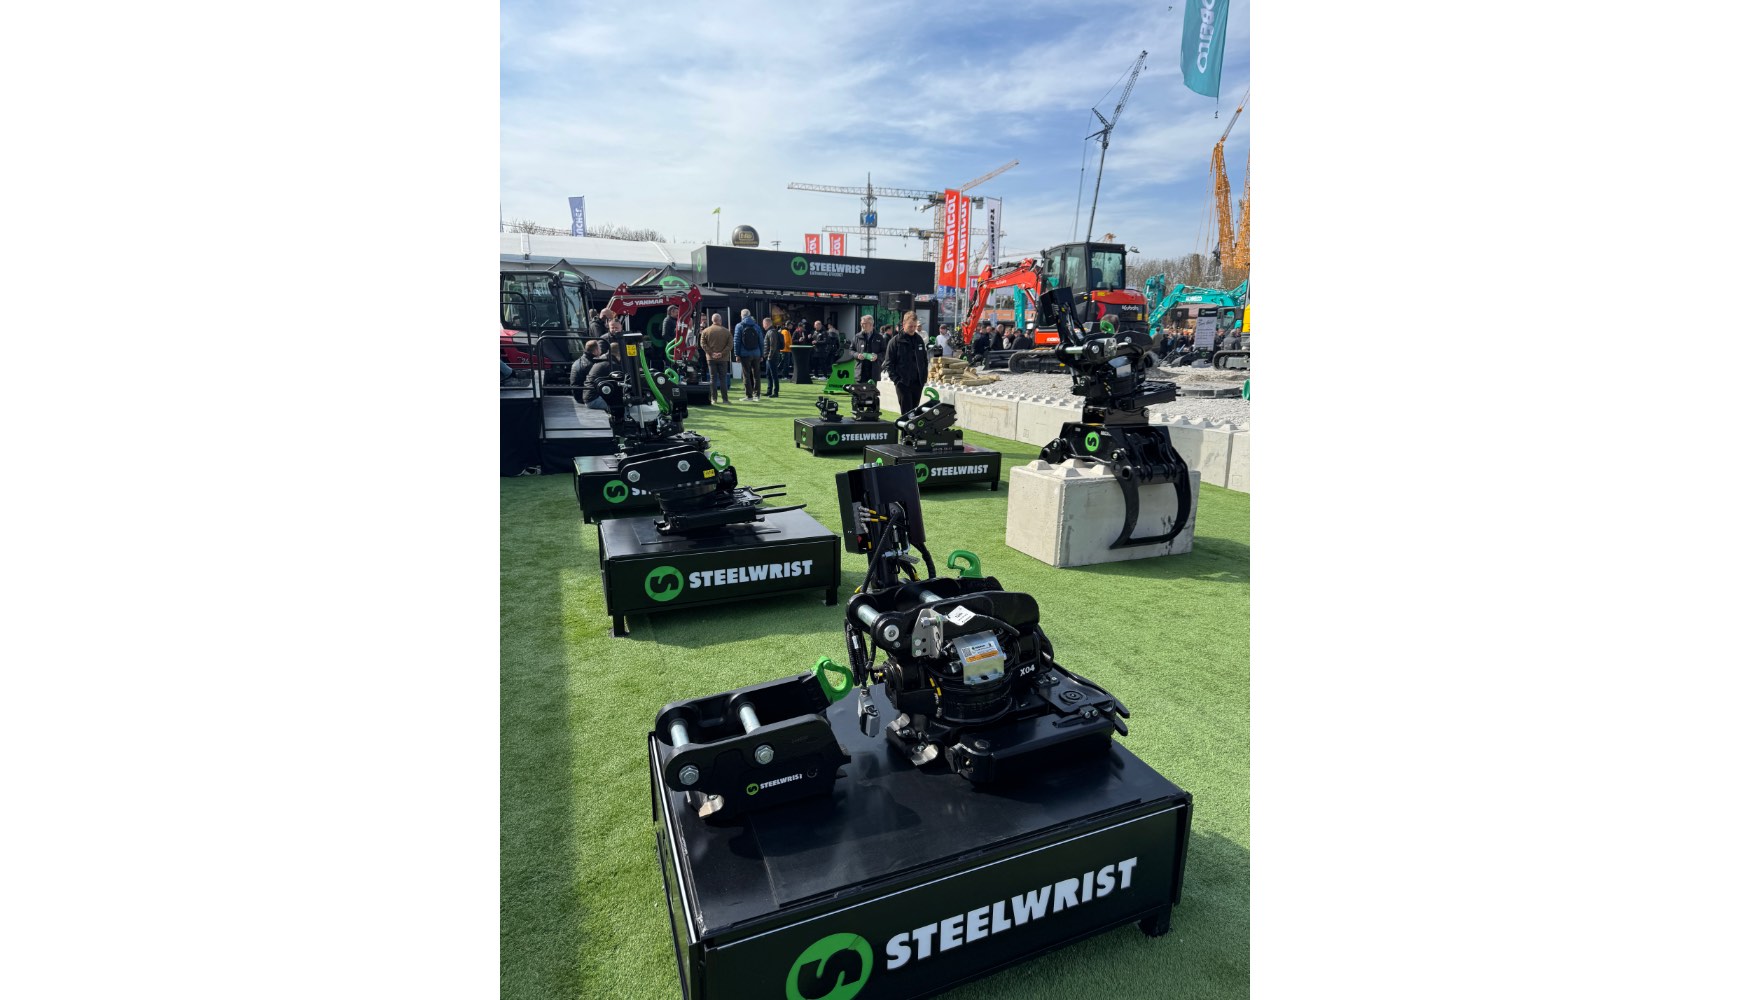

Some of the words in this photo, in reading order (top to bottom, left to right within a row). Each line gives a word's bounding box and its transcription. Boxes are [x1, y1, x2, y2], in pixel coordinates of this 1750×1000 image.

[810, 262, 866, 275] STEELWRIST
[841, 432, 889, 441] STEELWRIST
[931, 464, 989, 477] STEELWRIST
[689, 559, 813, 589] STEELWRIST
[1019, 665, 1035, 680] X04
[758, 774, 802, 790] STEELWRIST
[886, 857, 1138, 970] STEELWRIST
